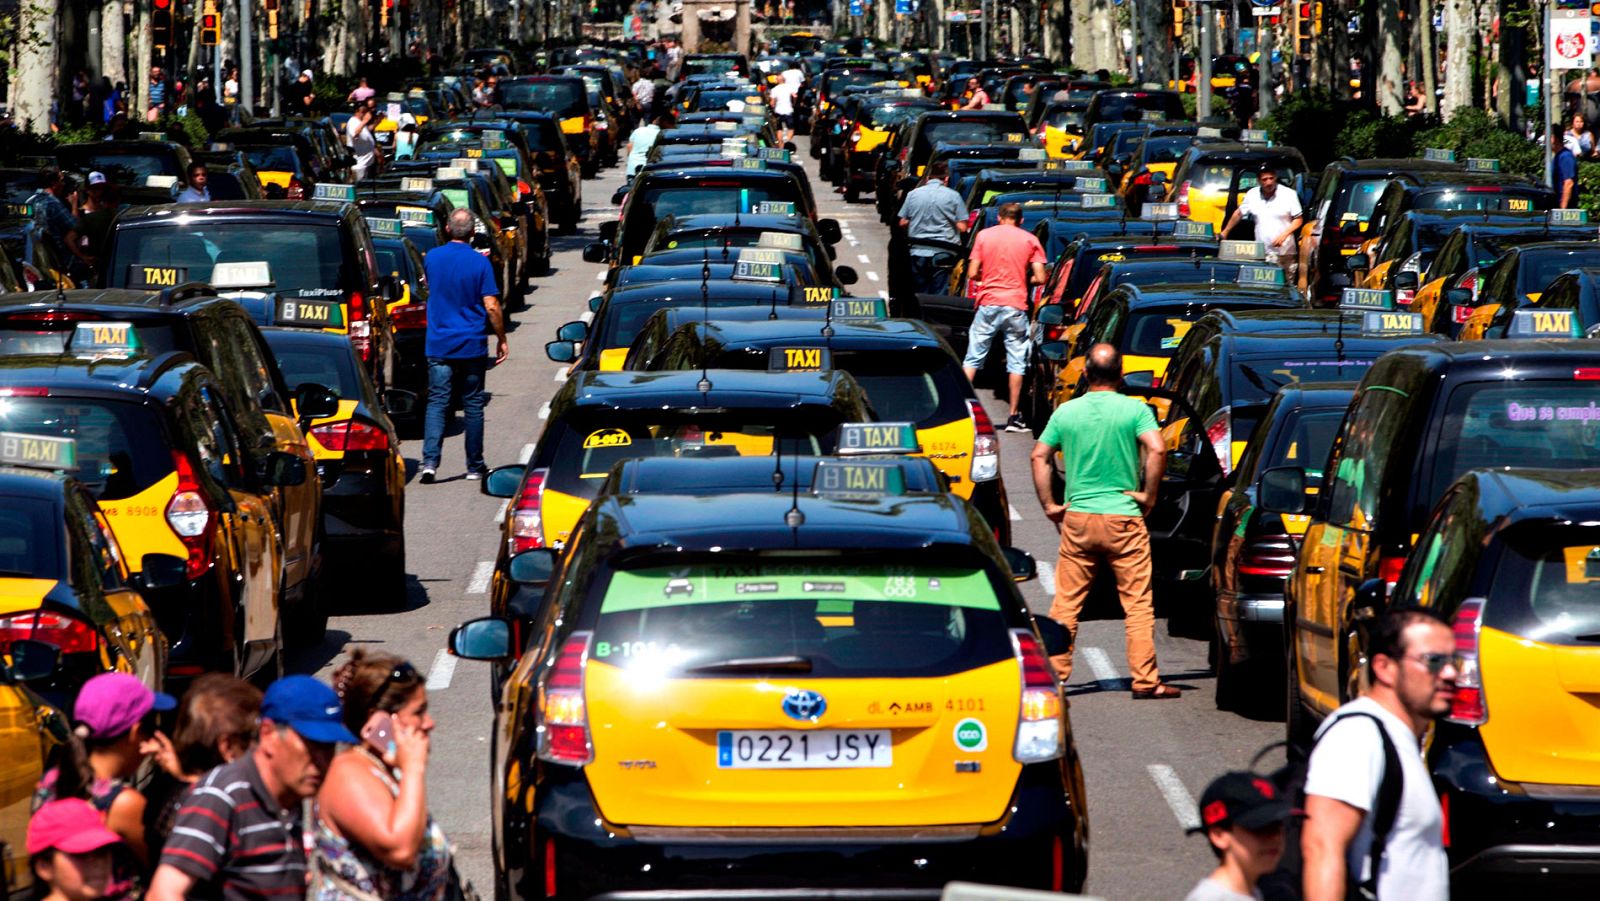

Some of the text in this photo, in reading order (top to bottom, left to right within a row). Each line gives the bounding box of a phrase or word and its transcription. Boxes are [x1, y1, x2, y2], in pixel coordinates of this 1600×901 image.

[1434, 151, 1449, 160] TAXI
[1477, 160, 1493, 169] TAXI
[327, 187, 347, 198] TAXI
[770, 203, 787, 214] TAXI
[1152, 205, 1170, 215] TAXI
[1508, 200, 1528, 210] TAXI
[1563, 211, 1580, 221] TAXI
[376, 221, 395, 232] TAXI
[1187, 223, 1206, 235] TAXI
[1235, 244, 1255, 255] TAXI
[144, 267, 177, 285] TAXI
[750, 264, 771, 276] TAXI
[1253, 269, 1276, 281] TAXI
[804, 287, 832, 302] TAXI
[1358, 291, 1382, 304] TAXI
[299, 304, 328, 320] TAXI
[848, 302, 874, 315] TAXI
[1381, 314, 1412, 329] TAXI
[1533, 312, 1569, 332] TAXI
[93, 327, 126, 344] TAXI
[784, 349, 820, 367] TAXI
[1508, 402, 1537, 421] Que
[1539, 407, 1554, 420] se
[863, 427, 898, 446] TAXI
[21, 439, 57, 461] TAXI
[931, 442, 957, 451] 6174
[844, 467, 884, 489] TAXI
[905, 703, 933, 713] AMB
[945, 699, 985, 712] 4101
[738, 734, 880, 762] 0221 JSY
